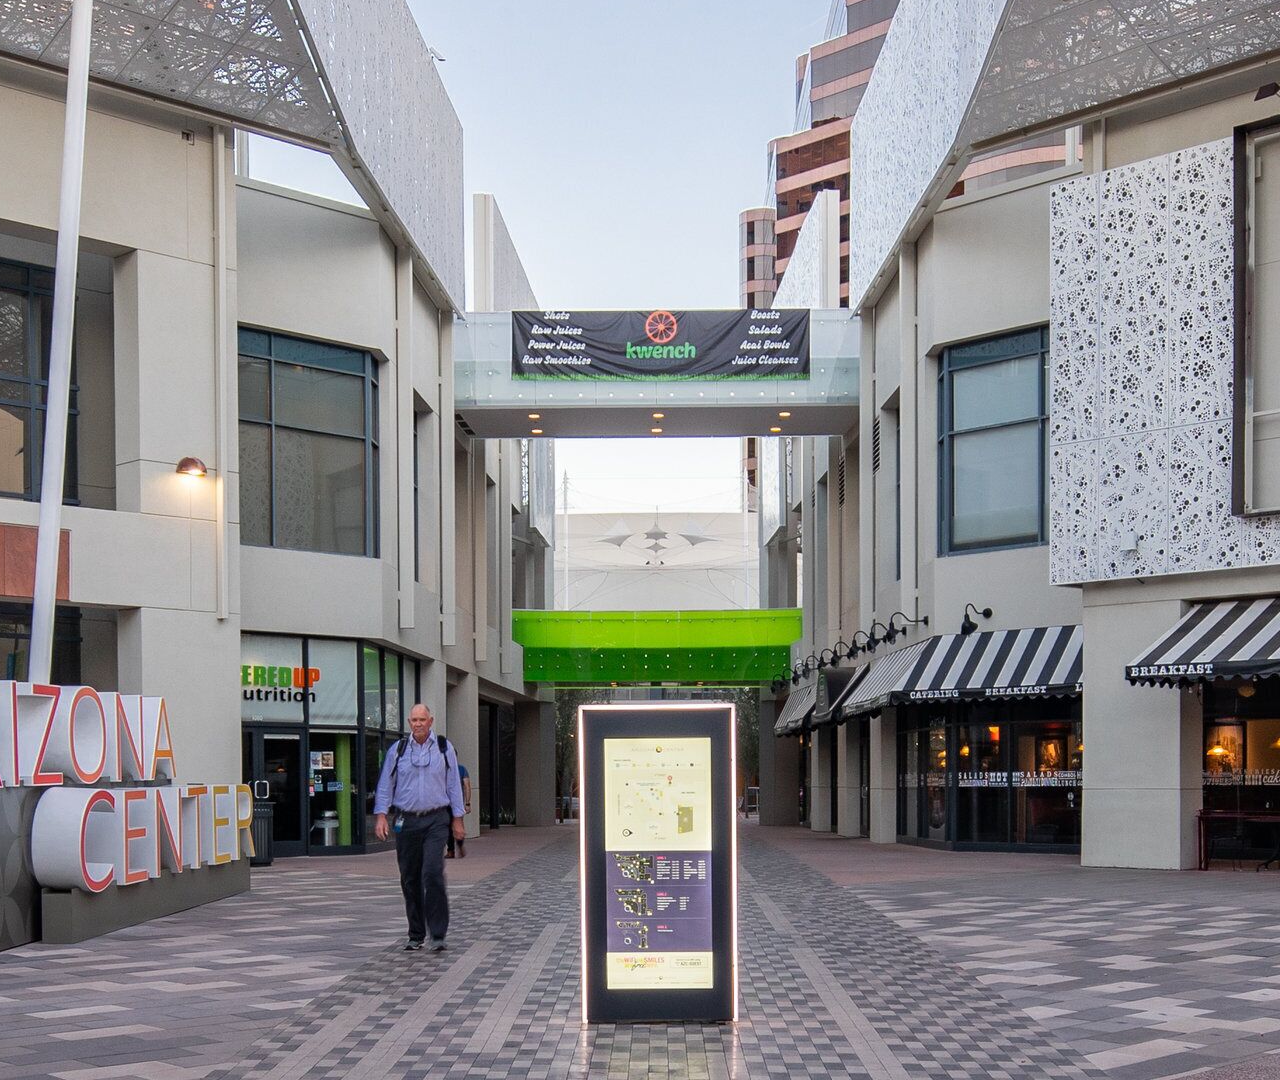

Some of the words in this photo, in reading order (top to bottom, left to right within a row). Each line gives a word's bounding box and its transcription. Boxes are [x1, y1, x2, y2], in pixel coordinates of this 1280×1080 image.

[544, 311, 570, 320] Shots
[750, 310, 781, 320] Boosts
[531, 325, 551, 335] Raw
[553, 325, 583, 336] Juices
[748, 324, 783, 335] Salads
[528, 339, 554, 350] Power
[556, 340, 587, 350] Juices
[740, 340, 762, 350] Acai
[763, 340, 791, 350] Bowls
[626, 341, 696, 360] kwench
[522, 355, 542, 365] Raw
[544, 355, 592, 366] Smoothies
[731, 355, 757, 366] Juice
[758, 355, 799, 365] Cleanses
[1131, 662, 1214, 678] BREAKFAST
[243, 687, 317, 703] utrition
[909, 689, 960, 700] CATERING
[984, 685, 1047, 697] BREAKFAST
[958, 772, 989, 780] SALADS
[1020, 771, 1058, 779] SALADS
[79, 784, 257, 893] CENTER
